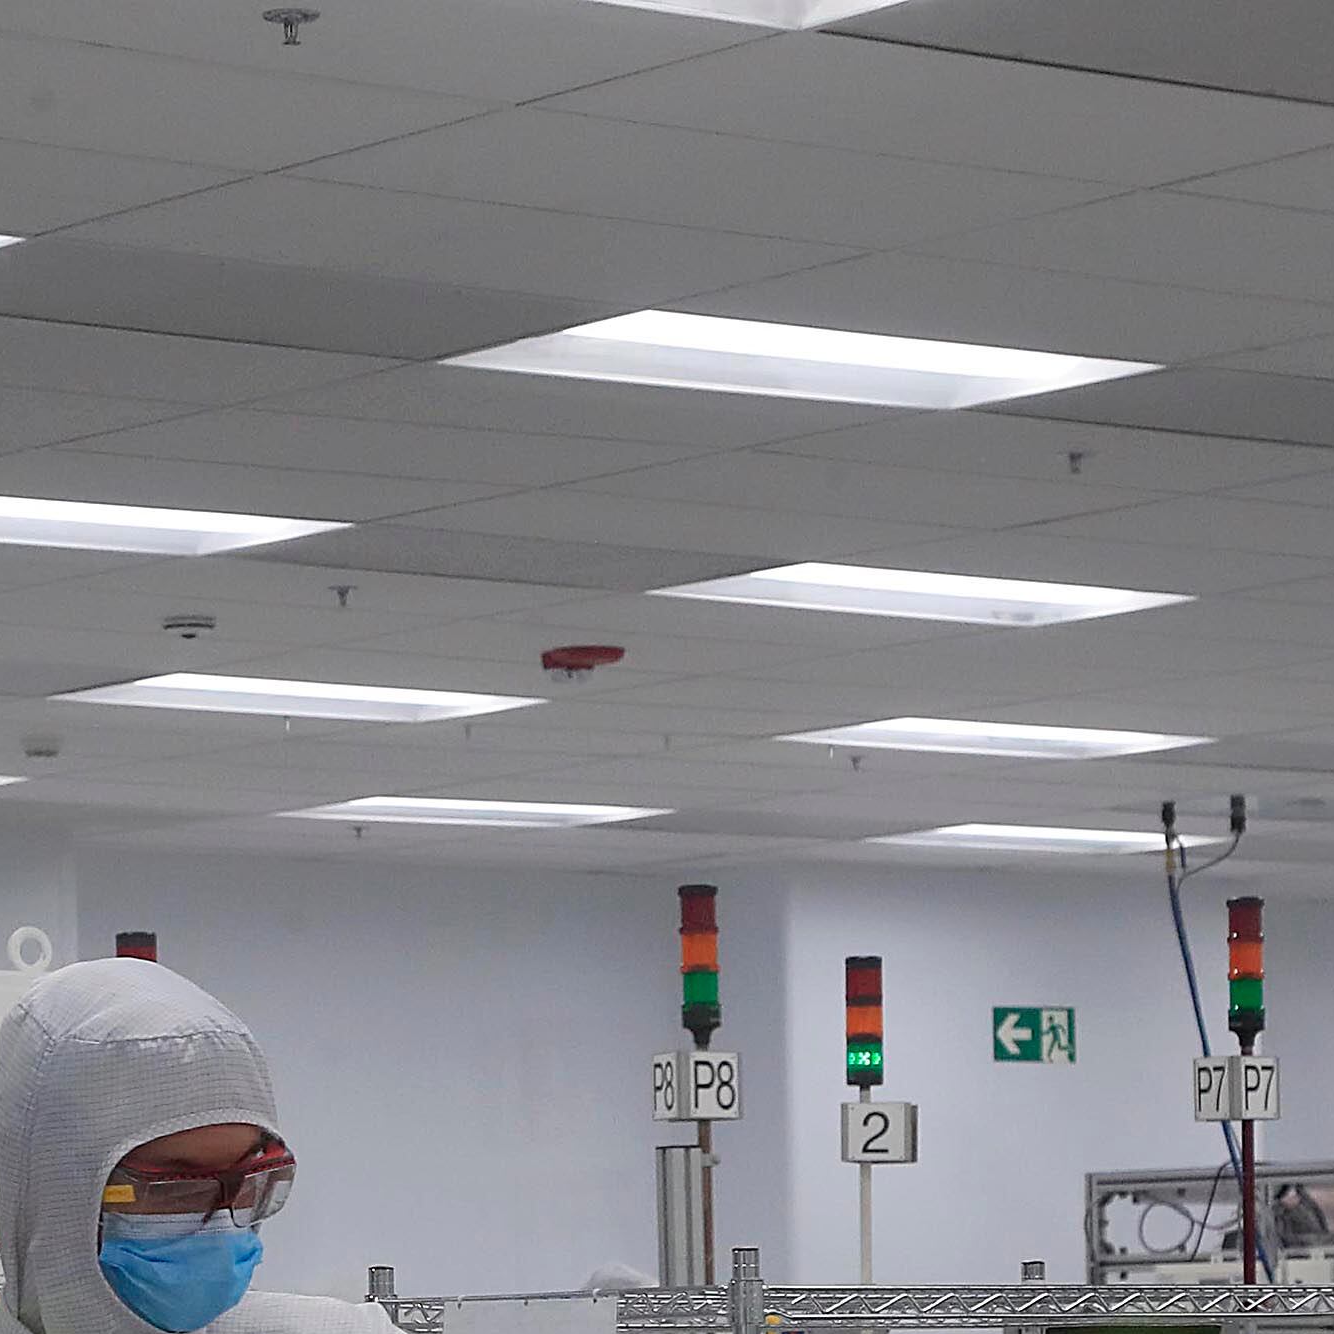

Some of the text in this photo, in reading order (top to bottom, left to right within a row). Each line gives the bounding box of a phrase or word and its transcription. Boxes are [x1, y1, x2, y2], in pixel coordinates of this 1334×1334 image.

[653, 1061, 674, 1111] P8
[694, 1060, 736, 1110] P8
[1197, 1066, 1226, 1112] P7
[1244, 1065, 1275, 1111] P7
[861, 1112, 890, 1153] 2
